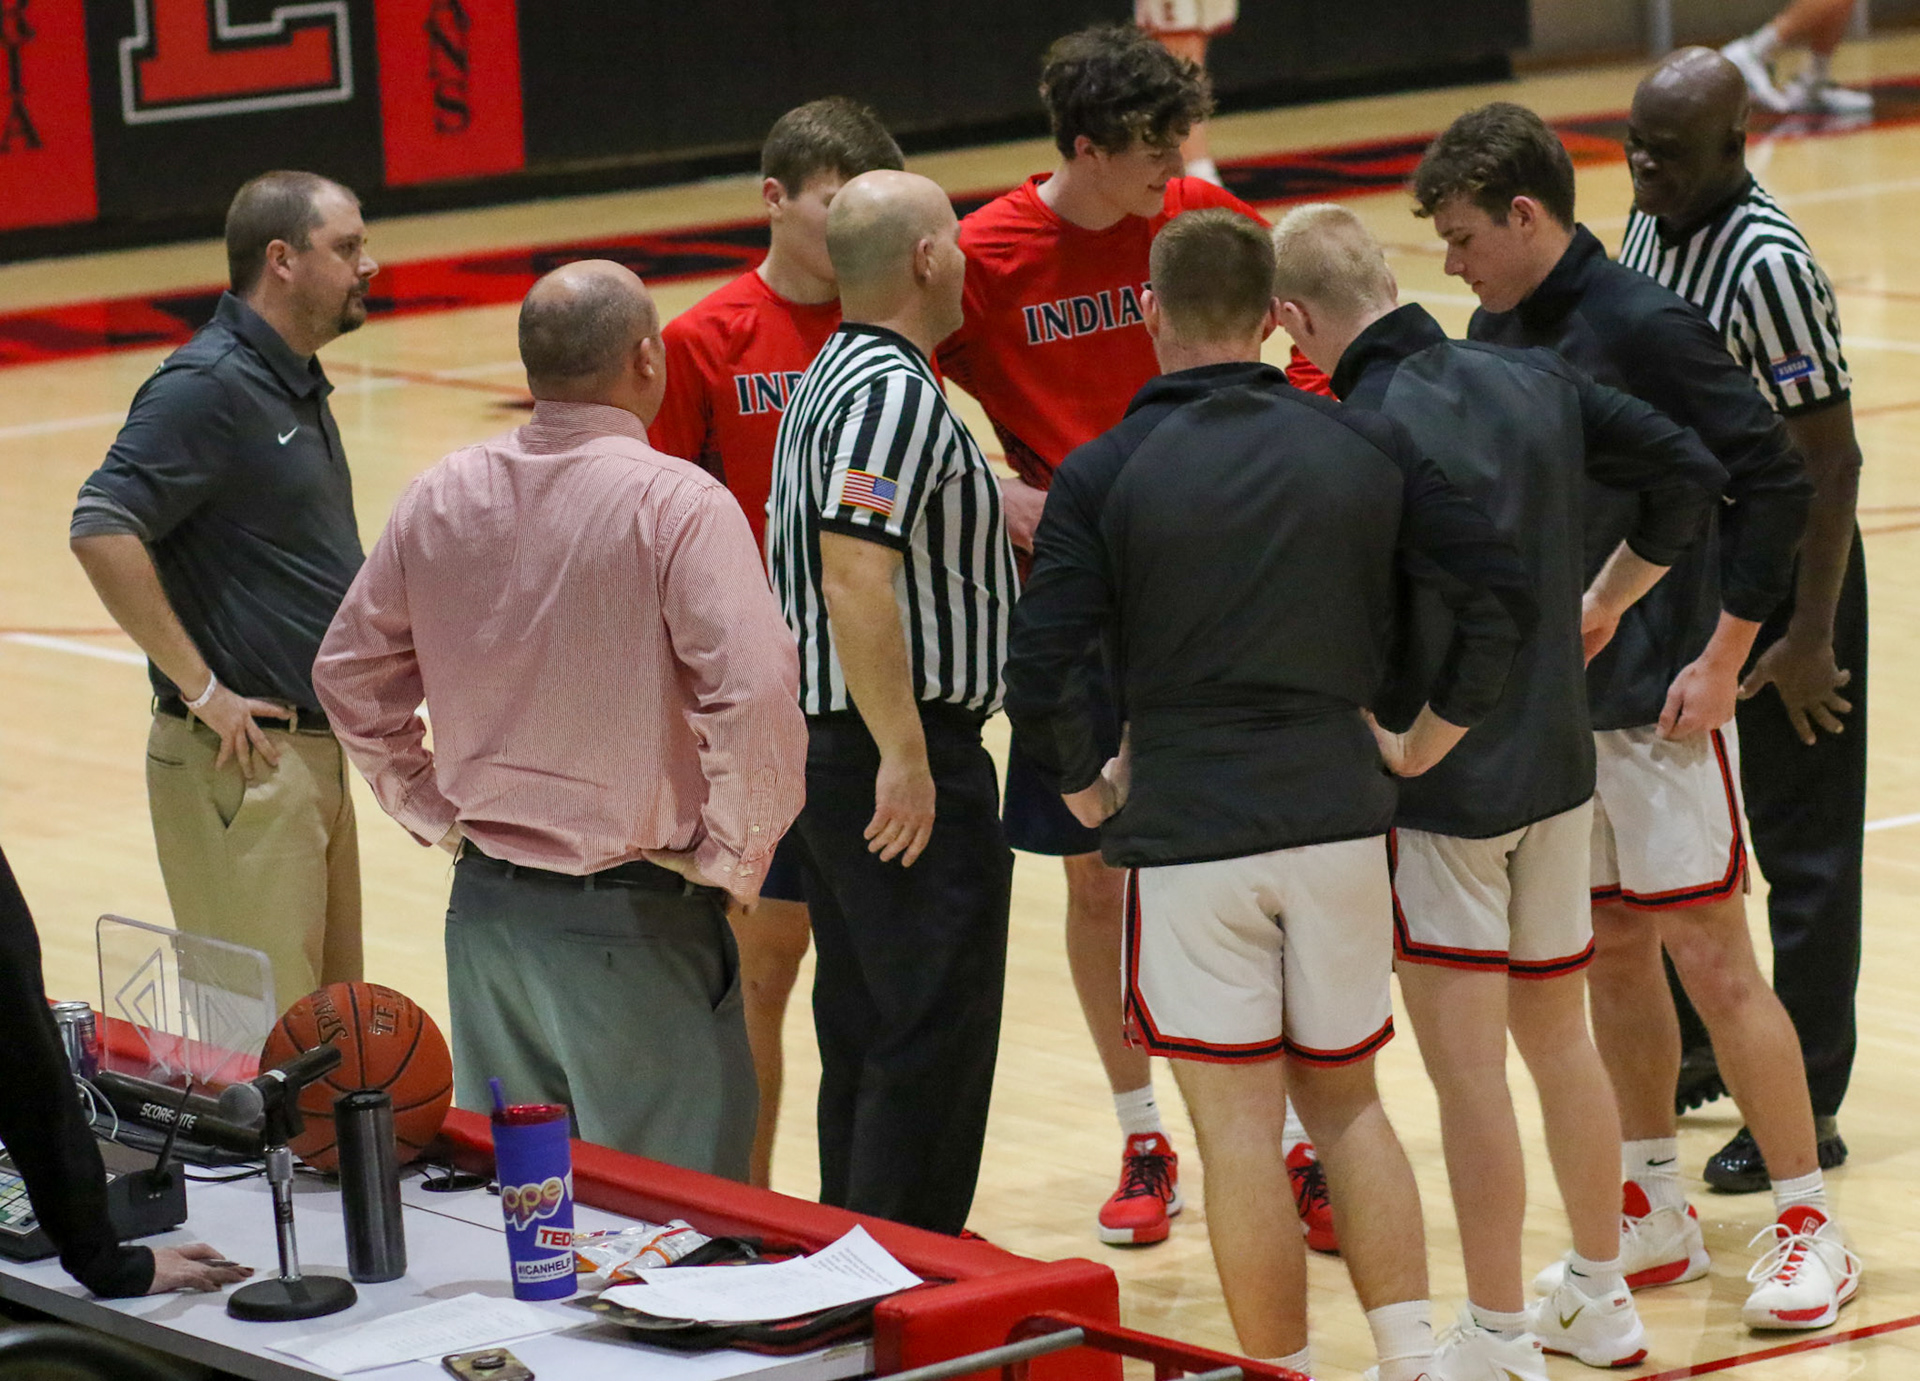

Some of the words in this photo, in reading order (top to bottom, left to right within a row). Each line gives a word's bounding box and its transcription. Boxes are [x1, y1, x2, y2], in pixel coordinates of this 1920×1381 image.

[1022, 281, 1152, 345] INDIA
[140, 1102, 198, 1129] SCORE-ITE
[540, 1229, 575, 1248] TED
